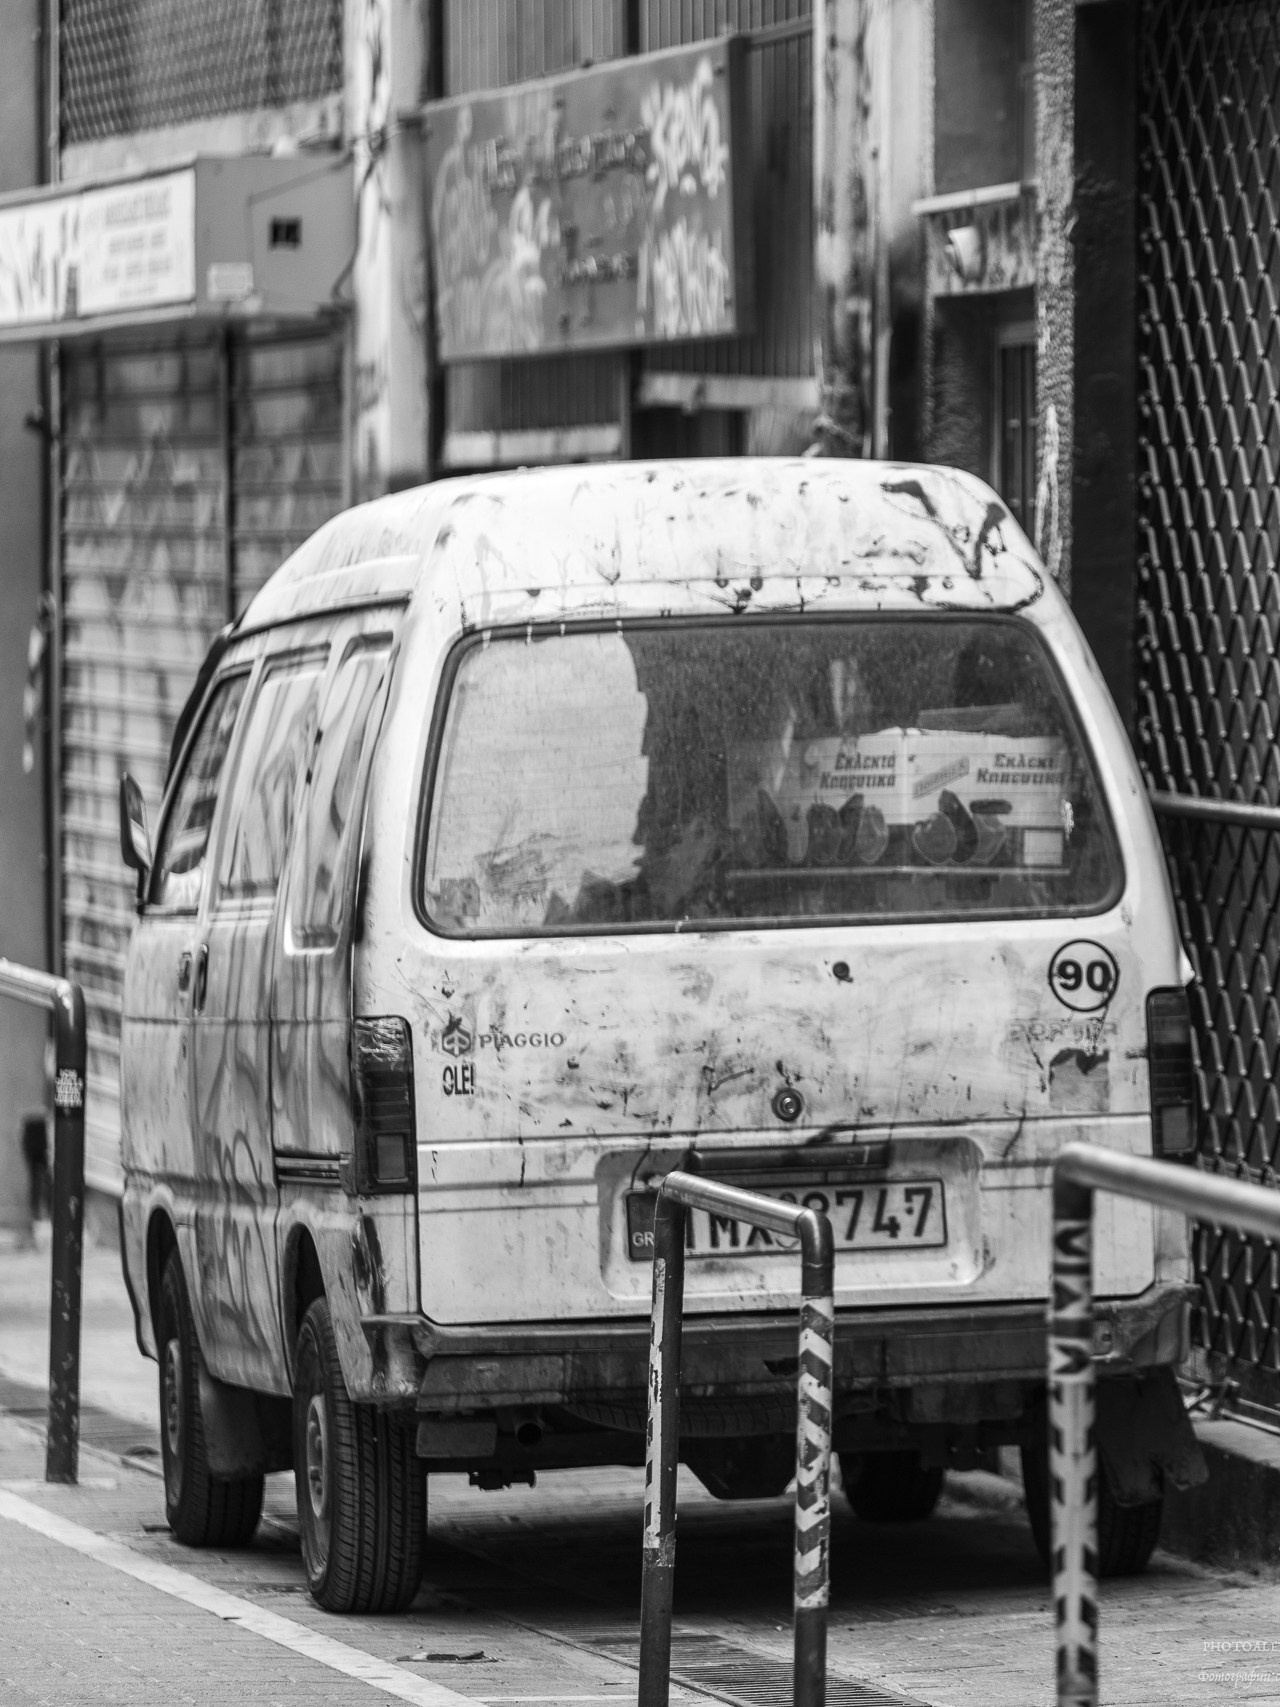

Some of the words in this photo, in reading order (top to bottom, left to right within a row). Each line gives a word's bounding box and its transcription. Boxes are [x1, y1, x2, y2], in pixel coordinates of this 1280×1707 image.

[994, 753, 1054, 769] Εκλεκτ
[1057, 959, 1113, 993] 90
[478, 1032, 565, 1049] PIAGGIO
[443, 1062, 475, 1096] OLE!
[632, 1231, 655, 1248] GR
